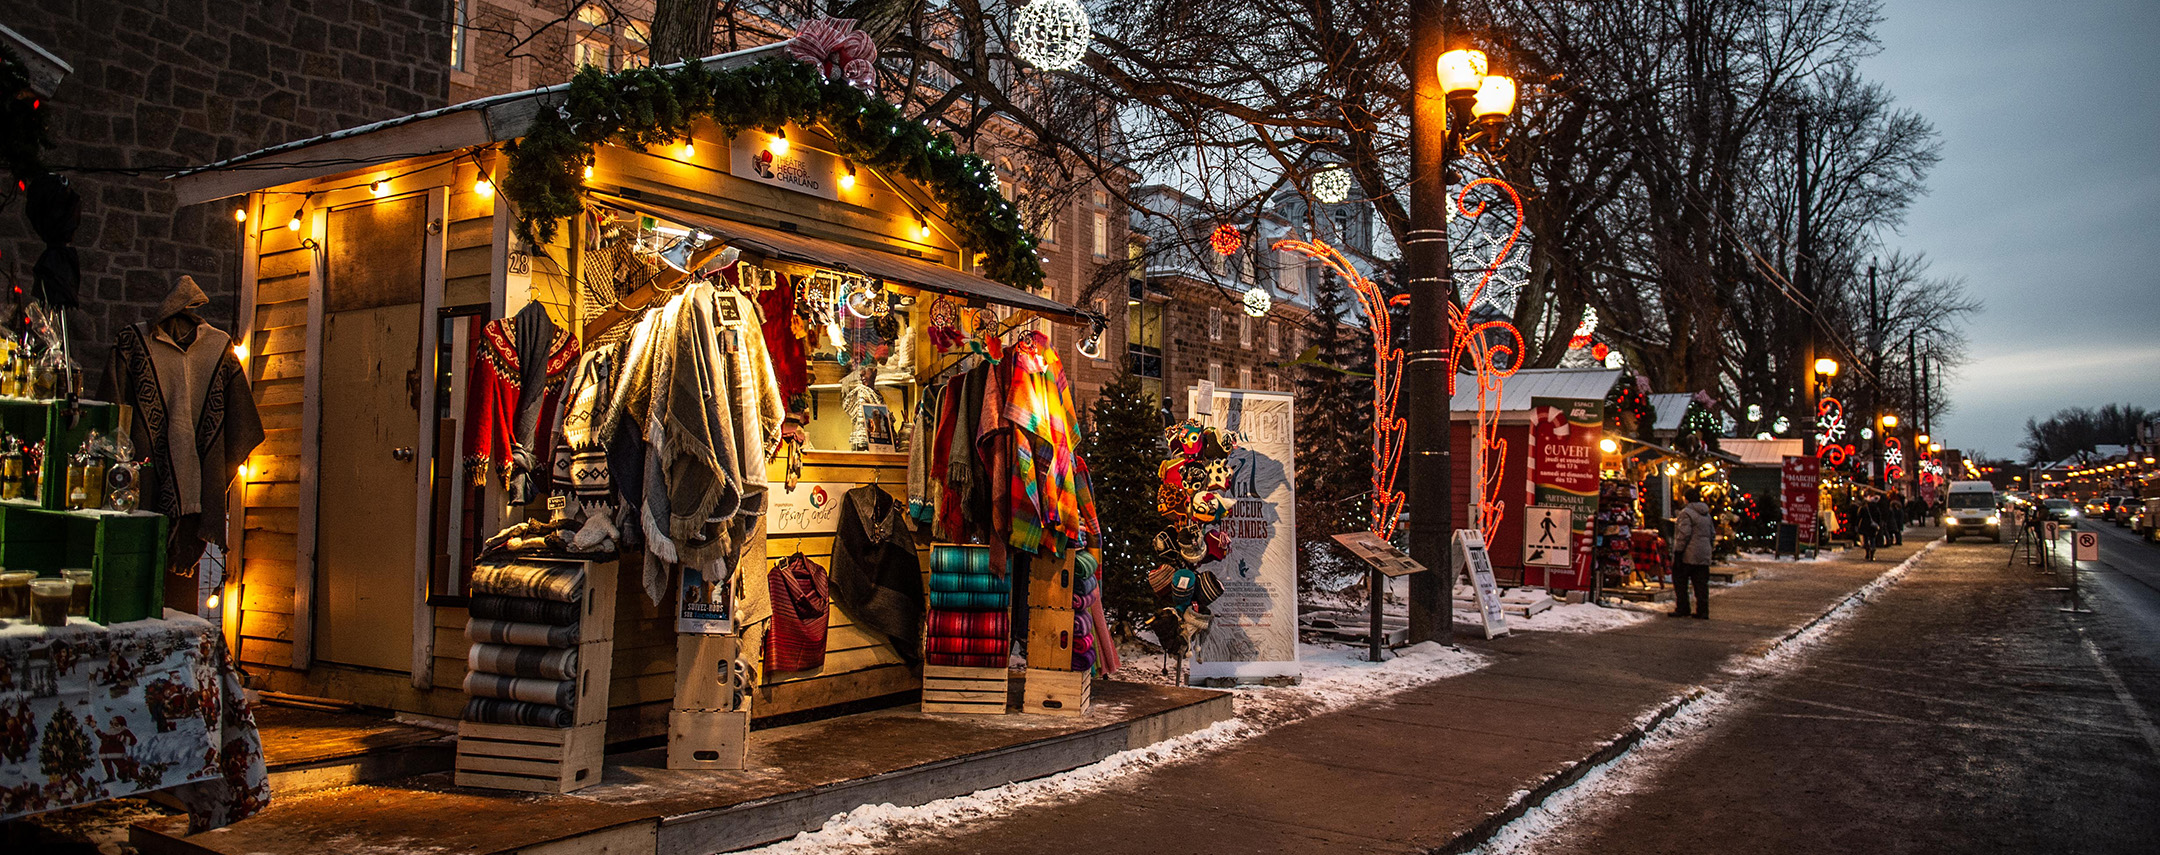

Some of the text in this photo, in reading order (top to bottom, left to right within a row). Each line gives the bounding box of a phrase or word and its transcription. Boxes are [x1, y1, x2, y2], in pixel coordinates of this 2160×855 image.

[777, 155, 805, 168] THÉÂTRE
[776, 172, 819, 189] CHARLAND
[509, 250, 530, 274] 28
[1544, 444, 1592, 458] OUVERT
[1237, 482, 1248, 498] LA
[1237, 521, 1268, 539] ANDES
[694, 611, 727, 619] facebook
